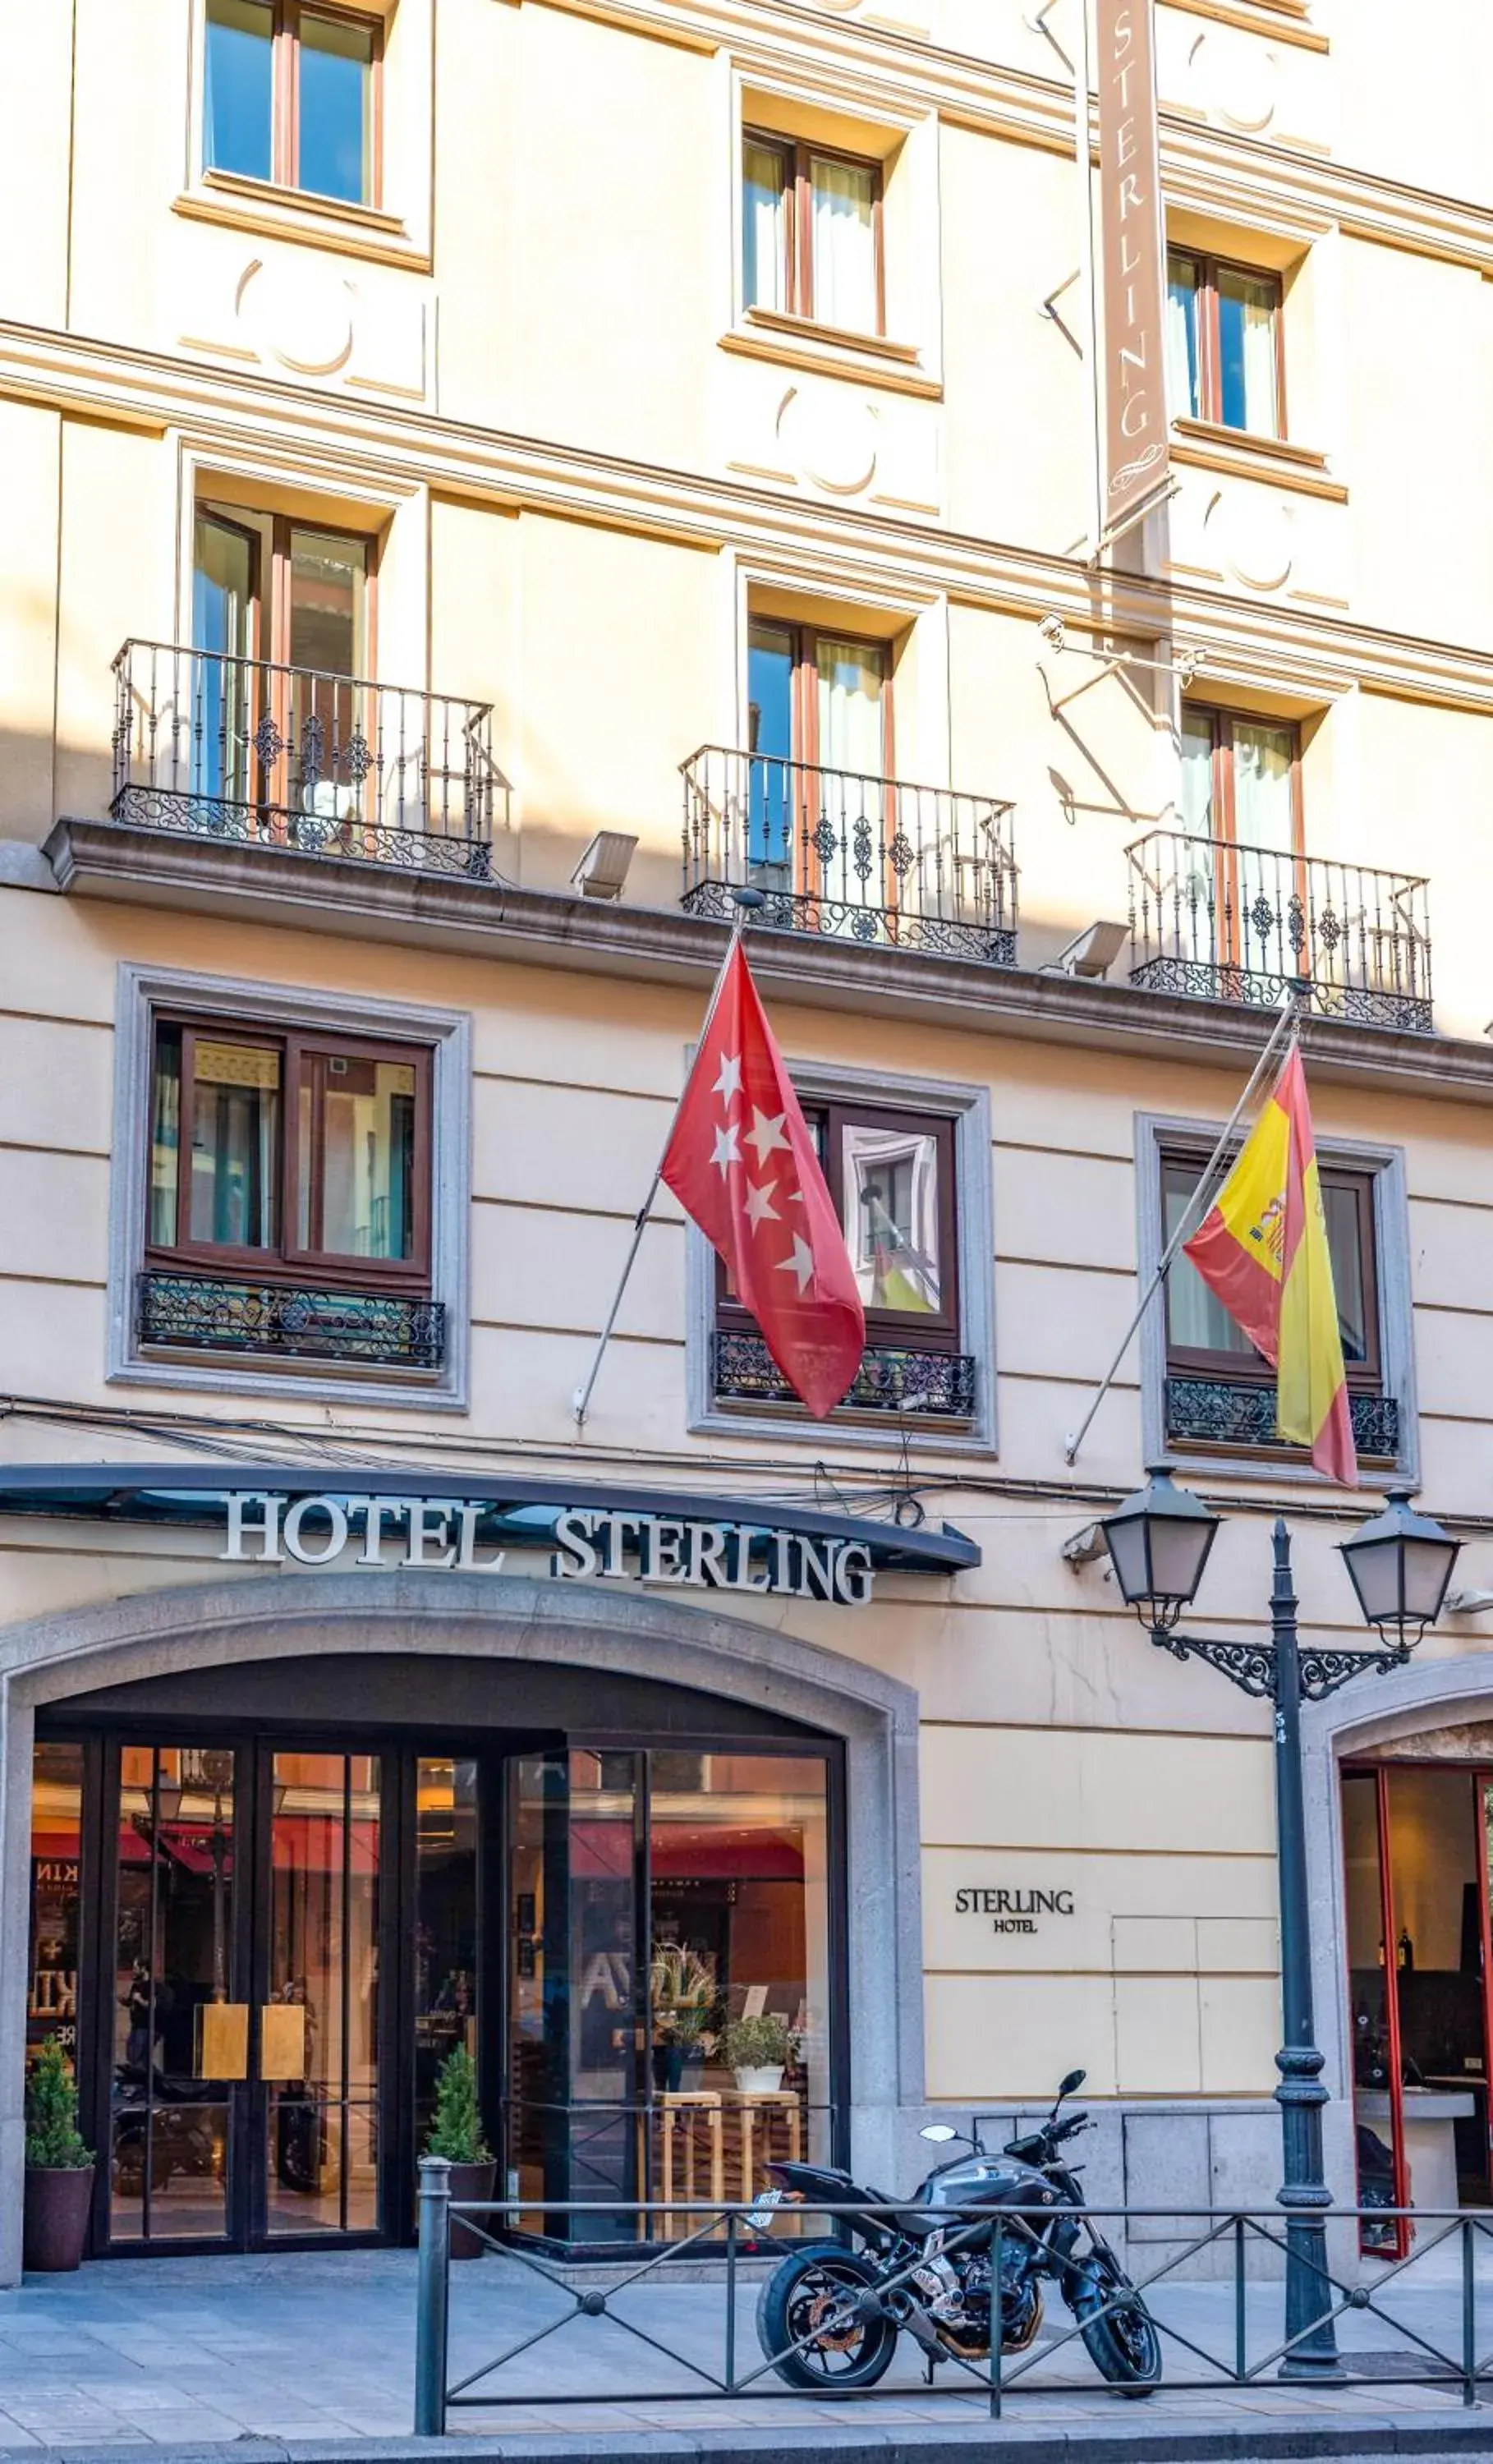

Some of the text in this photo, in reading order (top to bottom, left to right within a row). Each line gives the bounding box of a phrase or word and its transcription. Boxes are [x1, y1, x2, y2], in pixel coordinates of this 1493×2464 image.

[1112, 10, 1149, 438] STERLING
[218, 1495, 876, 1606] HOTEL STERLING
[955, 1888, 1074, 1915] STERLING
[994, 1919, 1038, 1933] HOTEL
